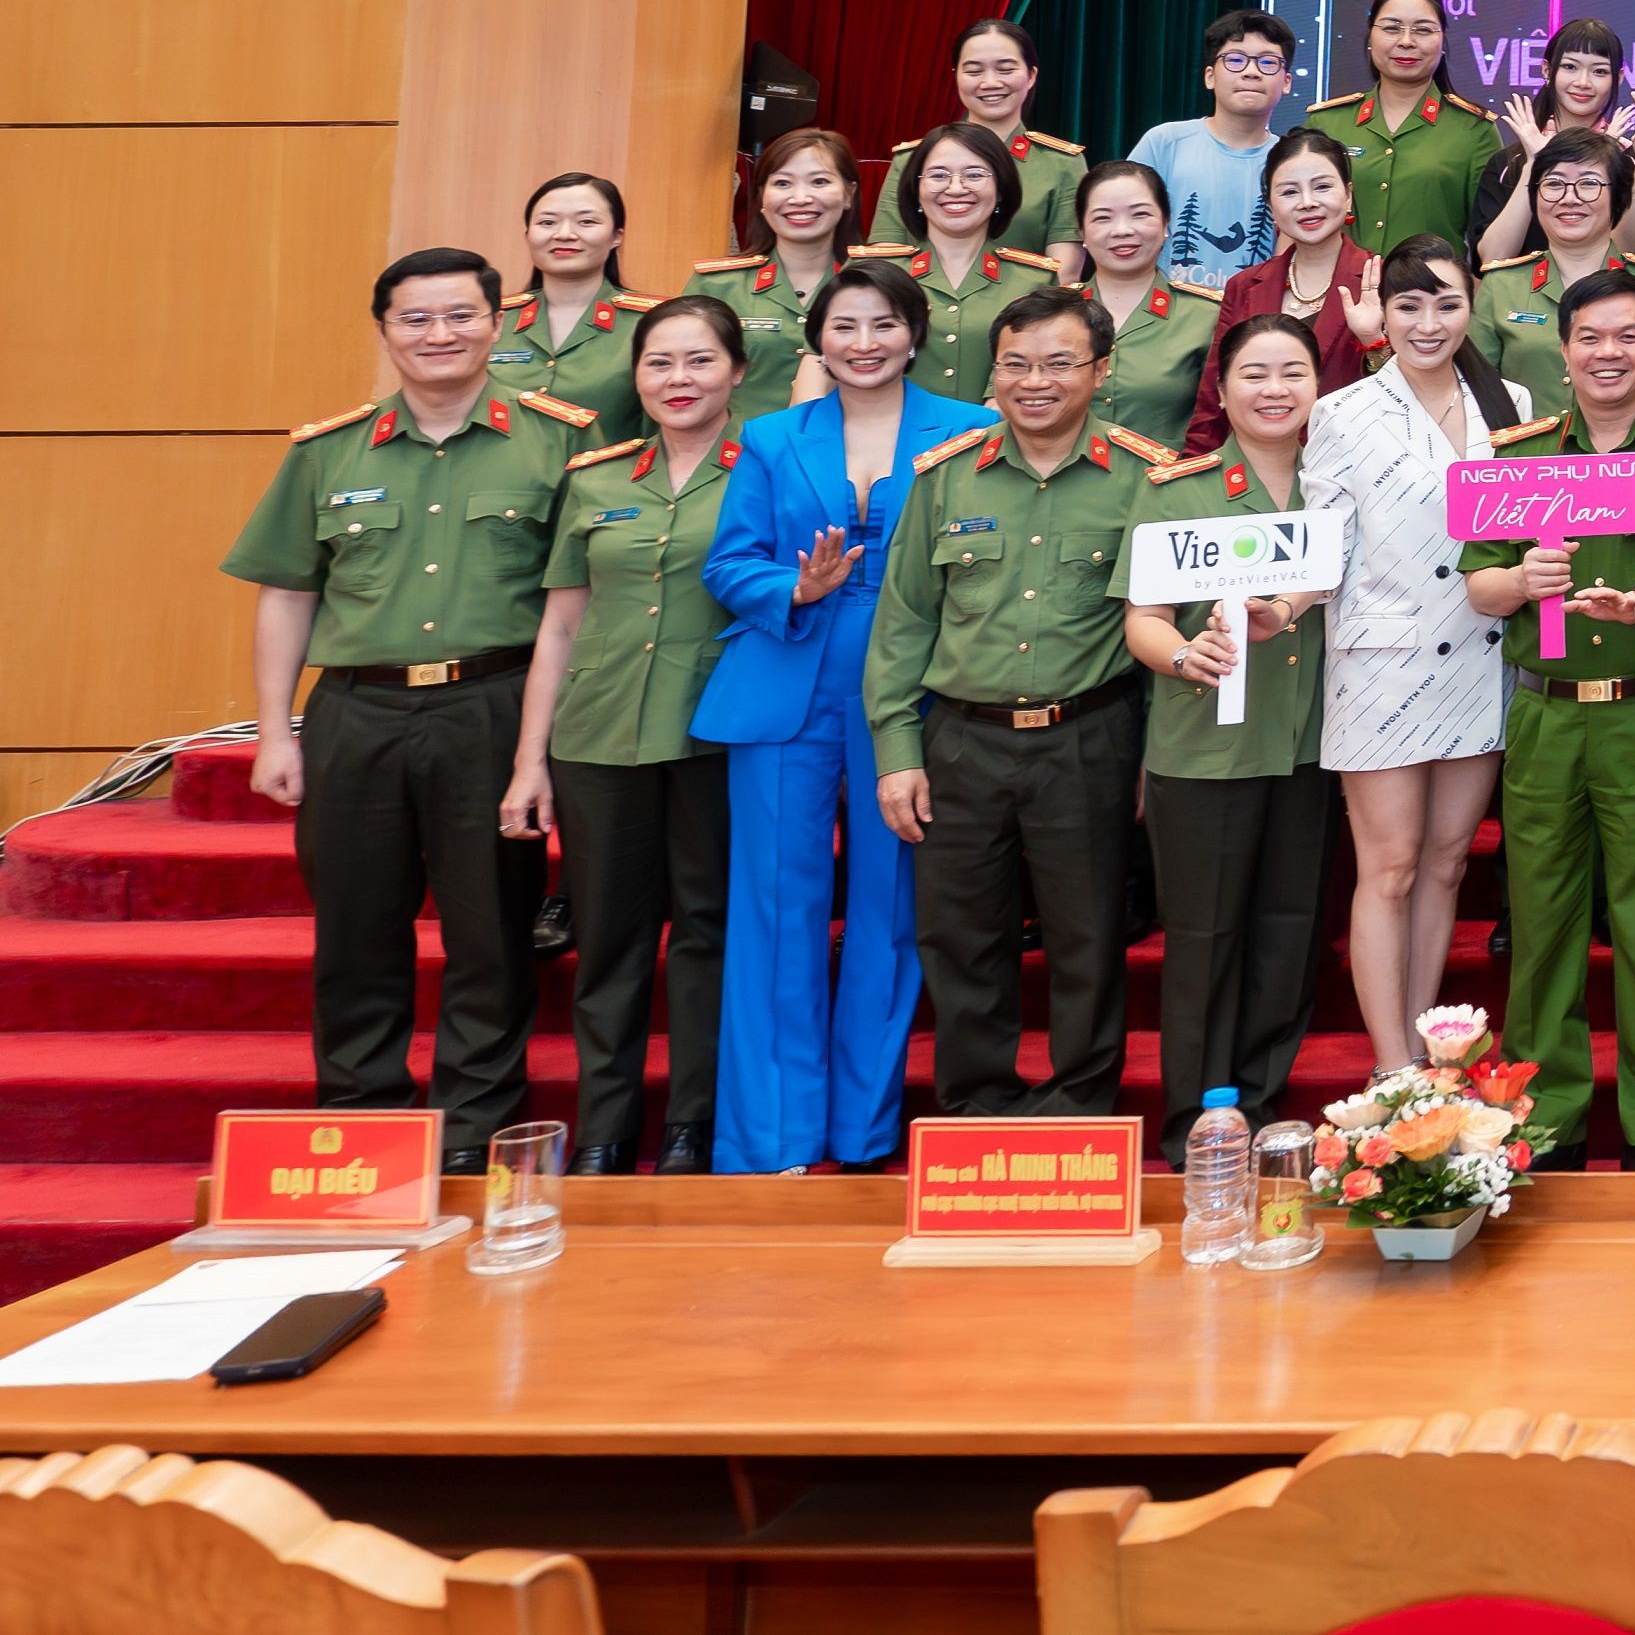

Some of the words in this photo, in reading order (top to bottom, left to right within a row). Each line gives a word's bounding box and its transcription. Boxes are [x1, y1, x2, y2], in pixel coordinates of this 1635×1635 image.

[1469, 28, 1550, 95] VIỆ
[1460, 464, 1528, 484] NGÀY
[1537, 465, 1590, 482] PHỤ
[1472, 492, 1552, 535] Việt
[1540, 487, 1627, 526] Nam
[1194, 579, 1212, 590] by
[1217, 570, 1309, 587] DatVietVAC
[1418, 673, 1436, 692] YOU
[270, 1167, 315, 1201] ĐẠI
